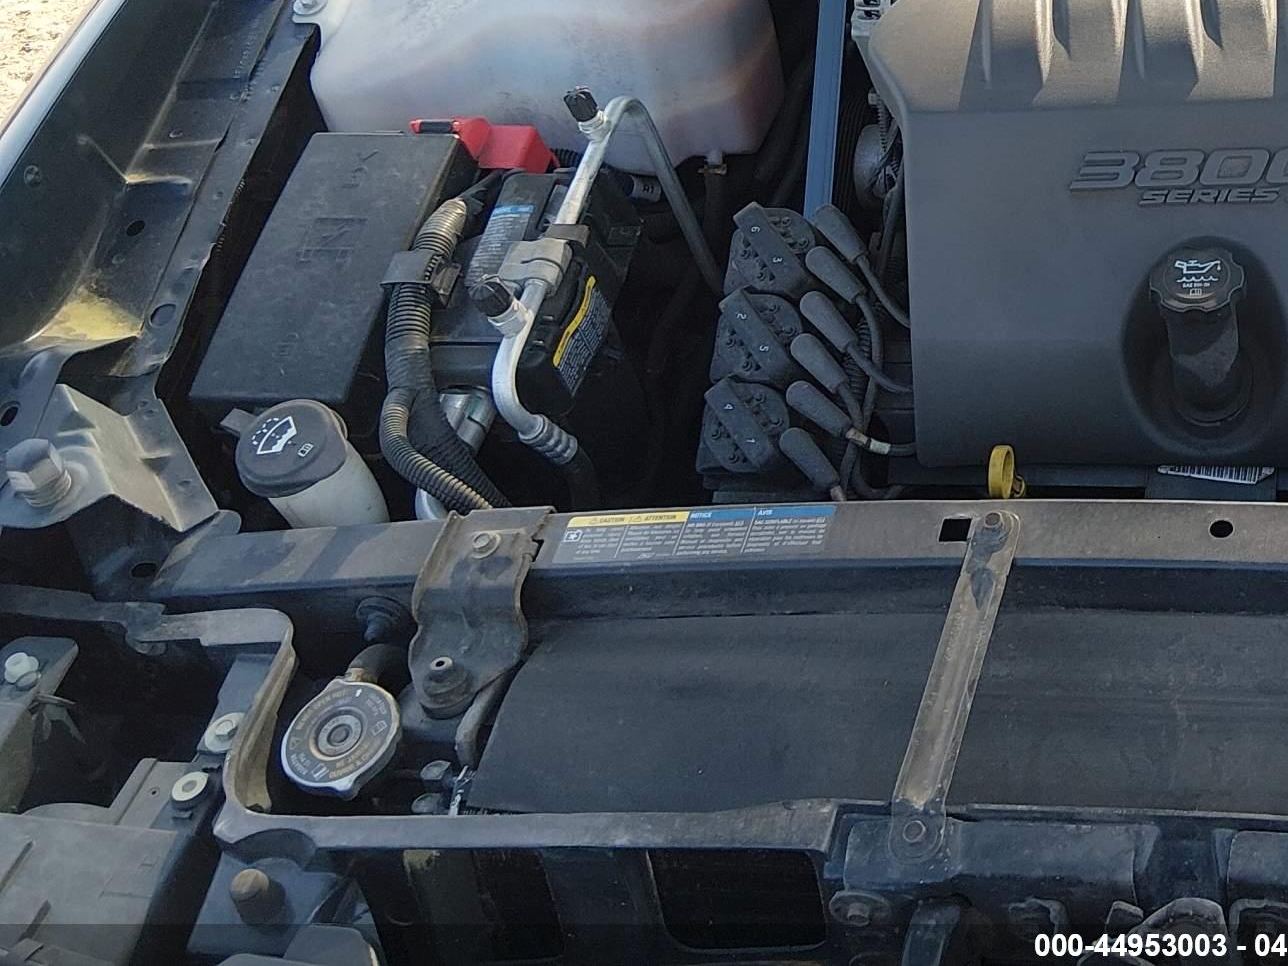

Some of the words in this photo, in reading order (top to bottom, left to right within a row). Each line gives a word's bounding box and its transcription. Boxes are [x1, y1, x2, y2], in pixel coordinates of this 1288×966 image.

[1138, 187, 1281, 205] SERIES
[749, 224, 761, 234] 6
[772, 255, 784, 265] 3
[735, 311, 748, 321] 2
[758, 343, 770, 353] 5
[722, 401, 735, 411] 4
[744, 436, 757, 445] 1
[643, 514, 677, 522] ATTENTION
[757, 508, 774, 516] AVIS
